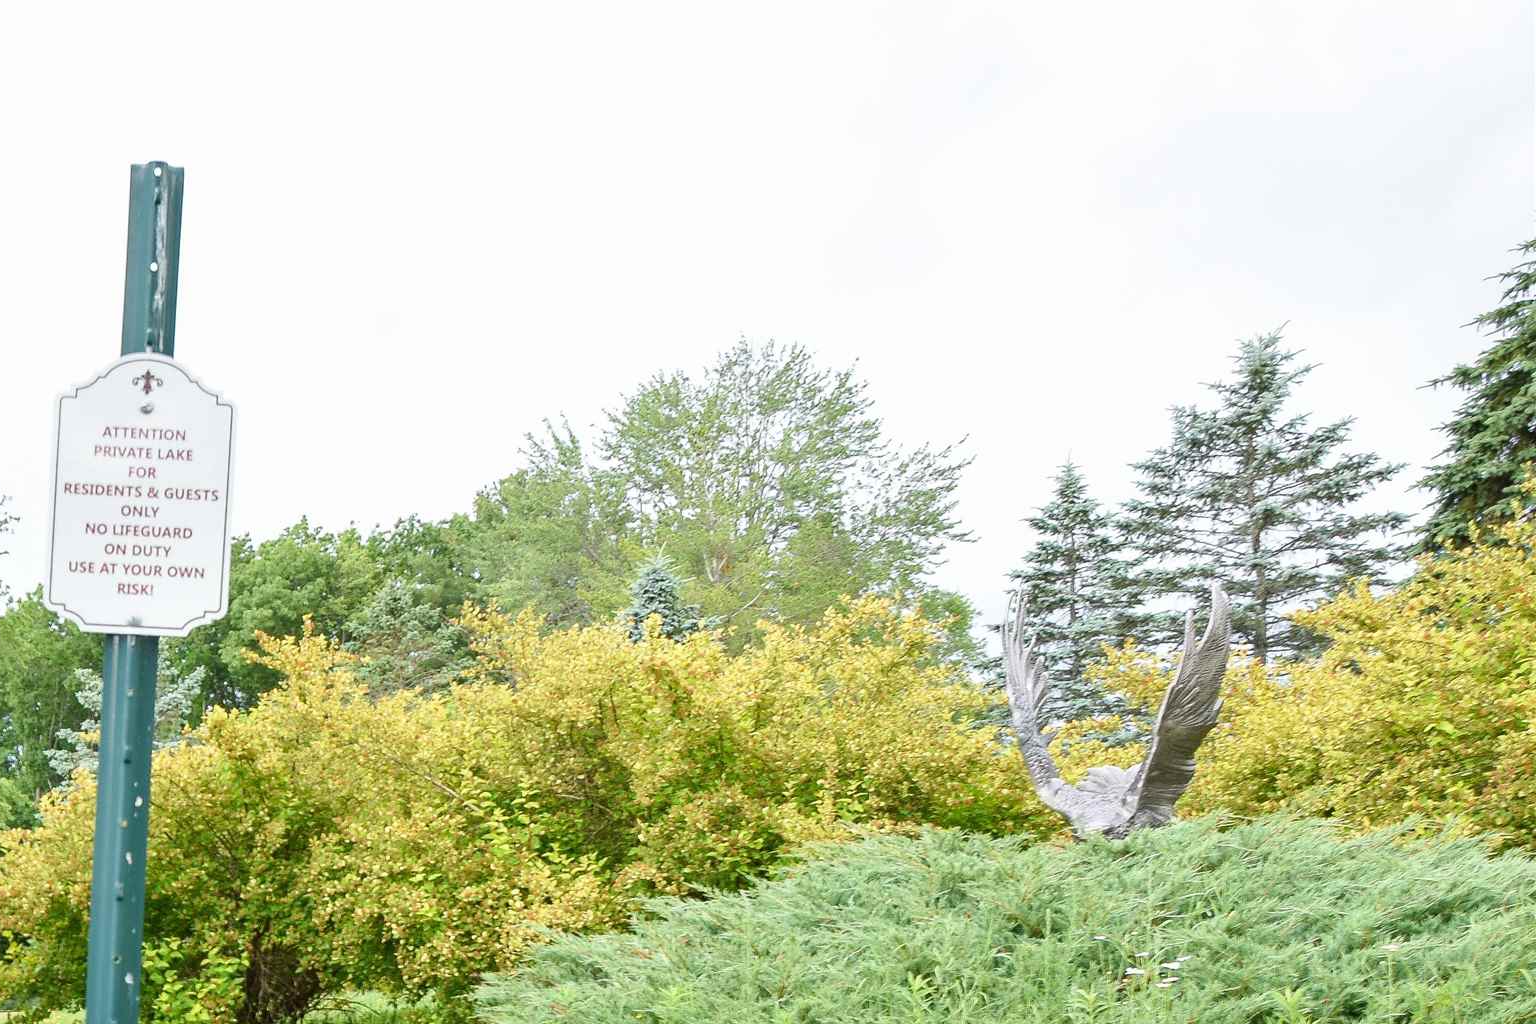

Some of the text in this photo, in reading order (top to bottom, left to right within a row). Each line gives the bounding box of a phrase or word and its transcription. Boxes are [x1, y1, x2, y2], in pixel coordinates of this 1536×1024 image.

[103, 426, 186, 441] ATTENTION
[94, 447, 193, 461] PRIVATE LAKE
[128, 467, 156, 479] FOR
[64, 483, 219, 501] RESIDENTS & GUESTS
[121, 505, 159, 518] ONLY
[85, 523, 193, 539] NO LIFEGUARD
[104, 543, 172, 557] ON DUTY
[69, 562, 205, 578] USE AT YOUR OWN
[117, 583, 154, 596] RISK!
